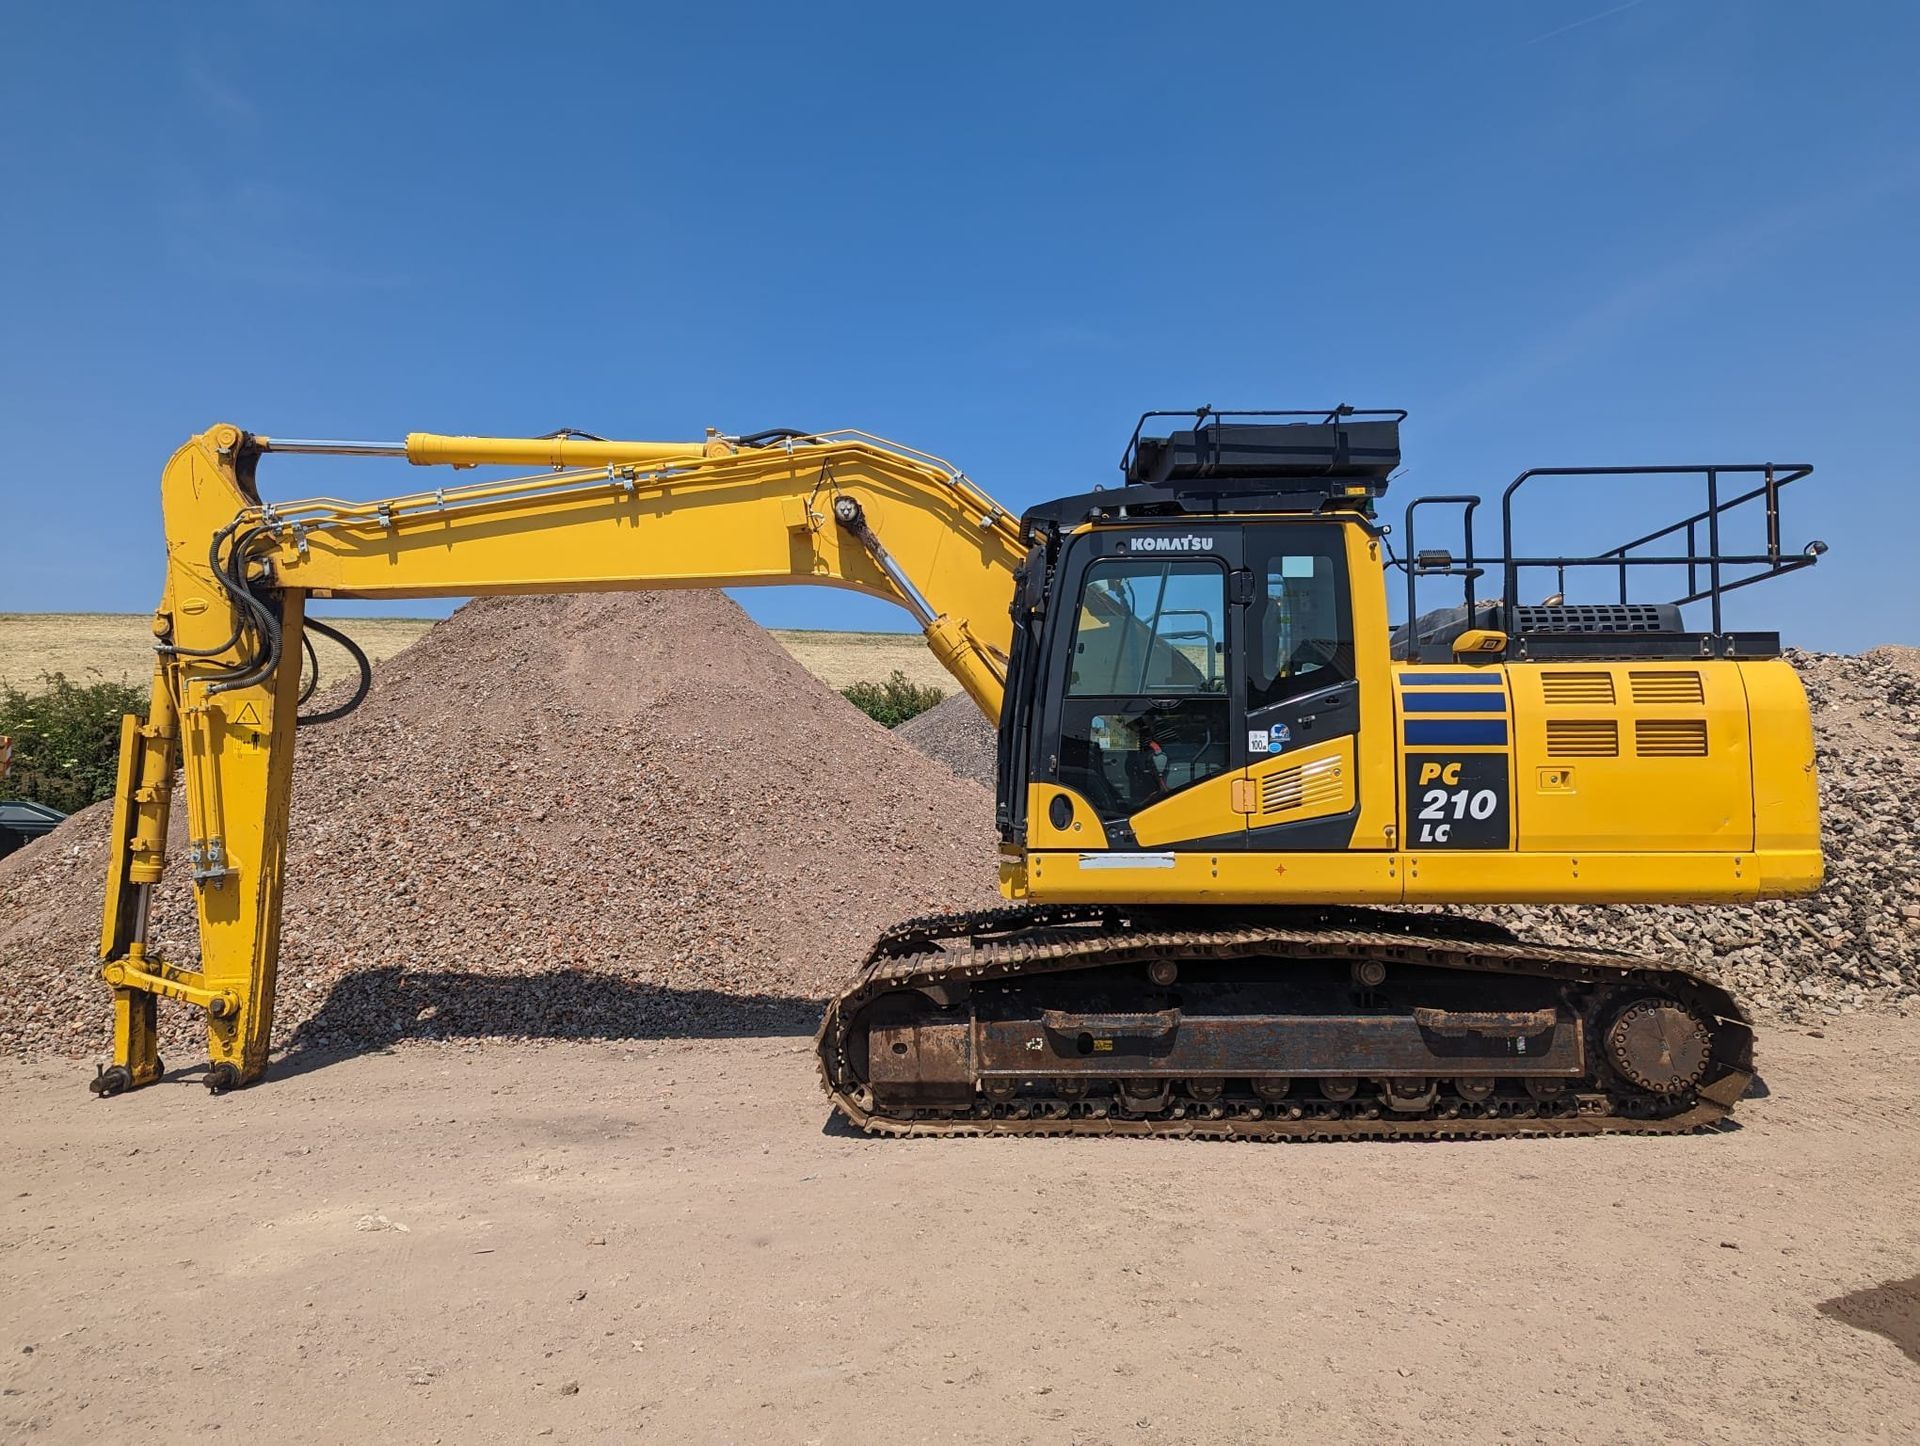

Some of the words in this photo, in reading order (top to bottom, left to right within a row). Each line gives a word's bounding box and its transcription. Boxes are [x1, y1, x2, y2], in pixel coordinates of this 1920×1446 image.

[1130, 534, 1214, 551] KOMATSU
[1251, 740, 1263, 750] 100
[1419, 762, 1462, 785] PC
[1418, 789, 1498, 820] 210
[1419, 824, 1451, 842] LC
